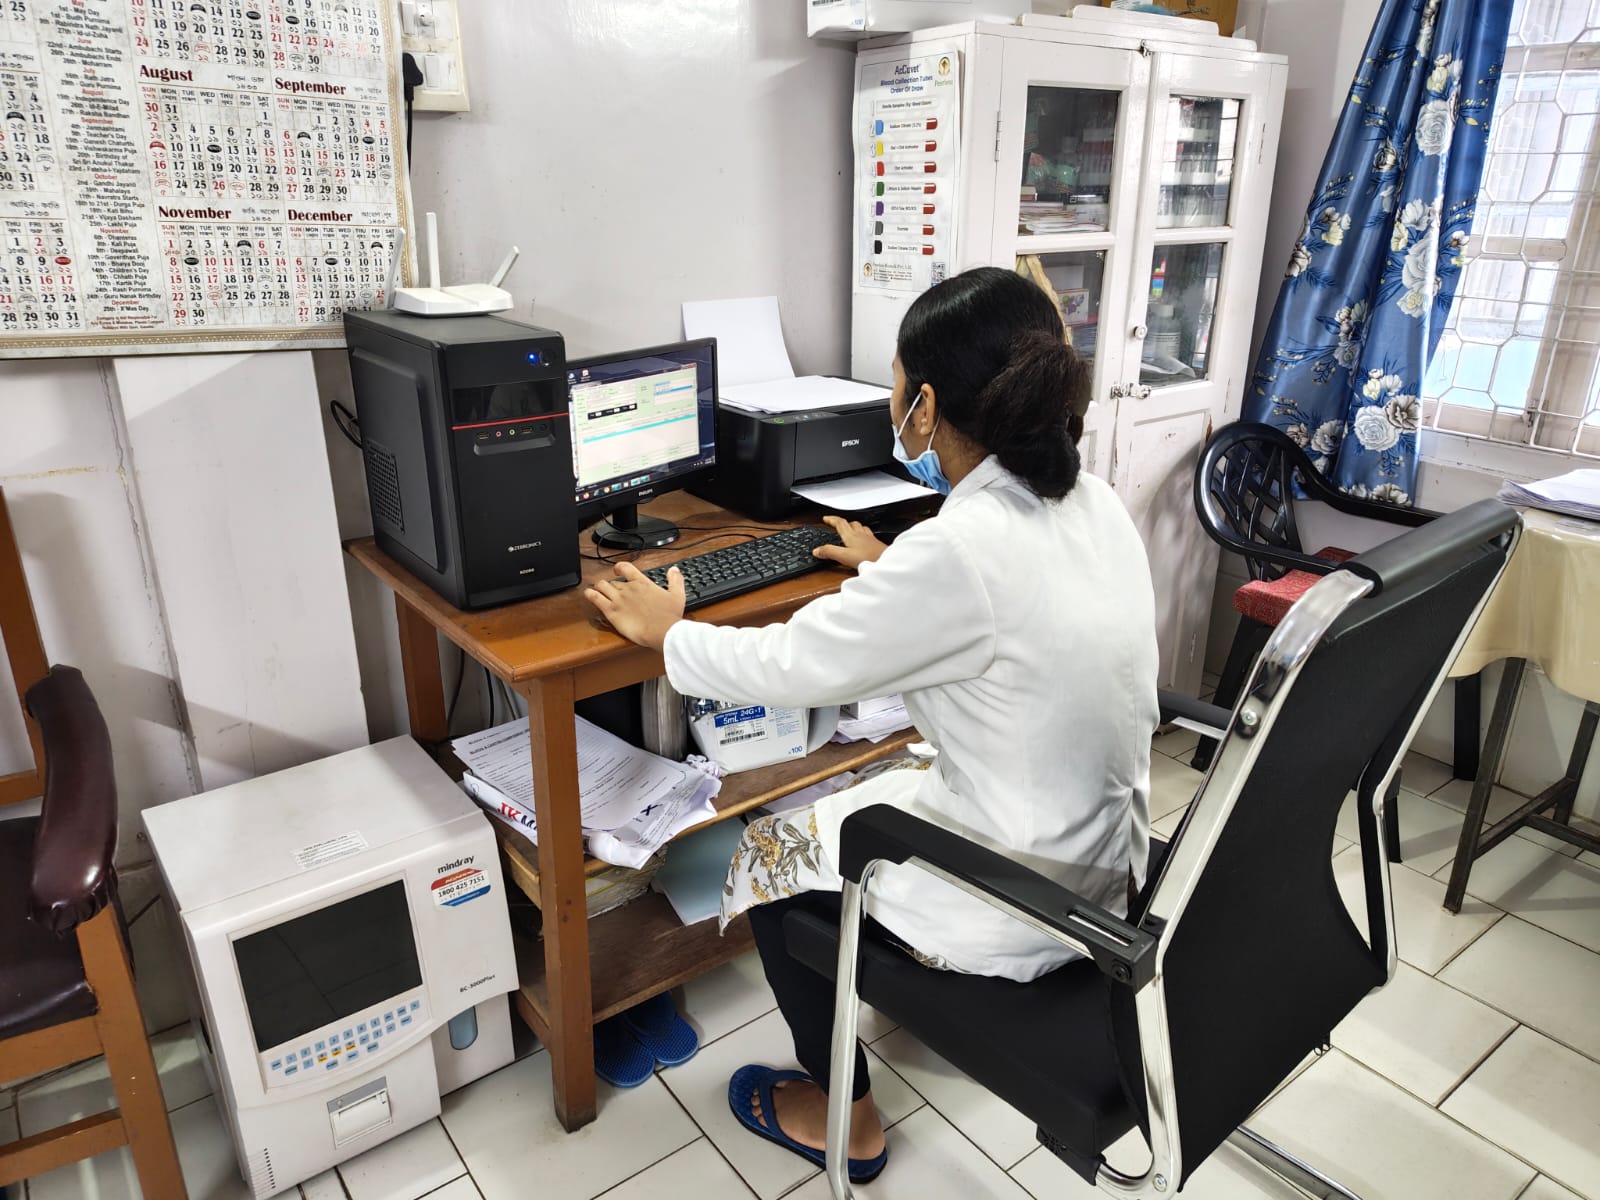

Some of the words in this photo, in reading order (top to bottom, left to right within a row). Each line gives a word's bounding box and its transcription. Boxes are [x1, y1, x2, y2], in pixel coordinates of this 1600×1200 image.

[10, 0, 26, 12] 25
[134, 17, 144, 26] 17
[154, 19, 167, 29] 18
[175, 22, 186, 31] 19
[193, 24, 206, 34] 20
[212, 26, 224, 36] 21
[232, 28, 244, 38] 22
[250, 30, 263, 40] 23
[271, 33, 282, 42] 21
[289, 34, 300, 44] 22
[306, 37, 318, 46] 23
[323, 39, 334, 48] 24
[136, 37, 148, 47] 24
[156, 39, 169, 49] 25
[176, 41, 189, 51] 26
[215, 45, 228, 56] 28
[234, 48, 246, 57] 29
[252, 50, 264, 59] 30
[140, 65, 194, 82] August
[274, 77, 346, 95] September
[145, 103, 159, 112] 30
[165, 104, 177, 113] 31
[13, 133, 26, 142] 17
[36, 134, 49, 143] 18
[171, 142, 183, 152] 10
[190, 144, 201, 152] 11
[228, 146, 239, 155] 13
[245, 147, 257, 156] 14
[264, 148, 275, 156] 15
[284, 149, 294, 158] 13
[301, 150, 311, 158] 14
[318, 151, 328, 160] 15
[334, 152, 344, 160] 16
[350, 152, 359, 161] 17
[365, 154, 375, 162] 18
[381, 154, 390, 163] 19
[154, 161, 166, 170] 16
[173, 162, 184, 170] 17
[192, 162, 205, 171] 18
[211, 163, 223, 172] 19
[229, 164, 241, 172] 20
[248, 164, 259, 173] 21
[265, 165, 277, 174] 22
[176, 180, 188, 189] 24
[194, 180, 207, 189] 25
[213, 181, 225, 190] 26
[249, 183, 262, 191] 28
[267, 183, 279, 192] 29
[287, 184, 297, 192] 27
[303, 184, 314, 193] 28
[320, 185, 331, 194] 29
[336, 186, 347, 195] 30
[158, 206, 231, 219] November
[288, 209, 353, 222] December
[18, 276, 31, 284] 15
[40, 276, 53, 284] 16
[60, 276, 72, 284] 17
[170, 275, 182, 283] 15
[189, 275, 200, 283] 16
[225, 275, 237, 283] 18
[41, 294, 56, 303] 23
[62, 294, 76, 302] 24
[24, 312, 38, 322] 29
[45, 312, 59, 321] 30
[66, 312, 79, 320] 31
[174, 310, 186, 318] 29
[315, 307, 325, 315] 28
[842, 439, 859, 447] EPSON
[723, 716, 738, 724] 5mL
[438, 856, 474, 874] mindray
[438, 887, 454, 897] 1800
[470, 876, 484, 884] 7151
